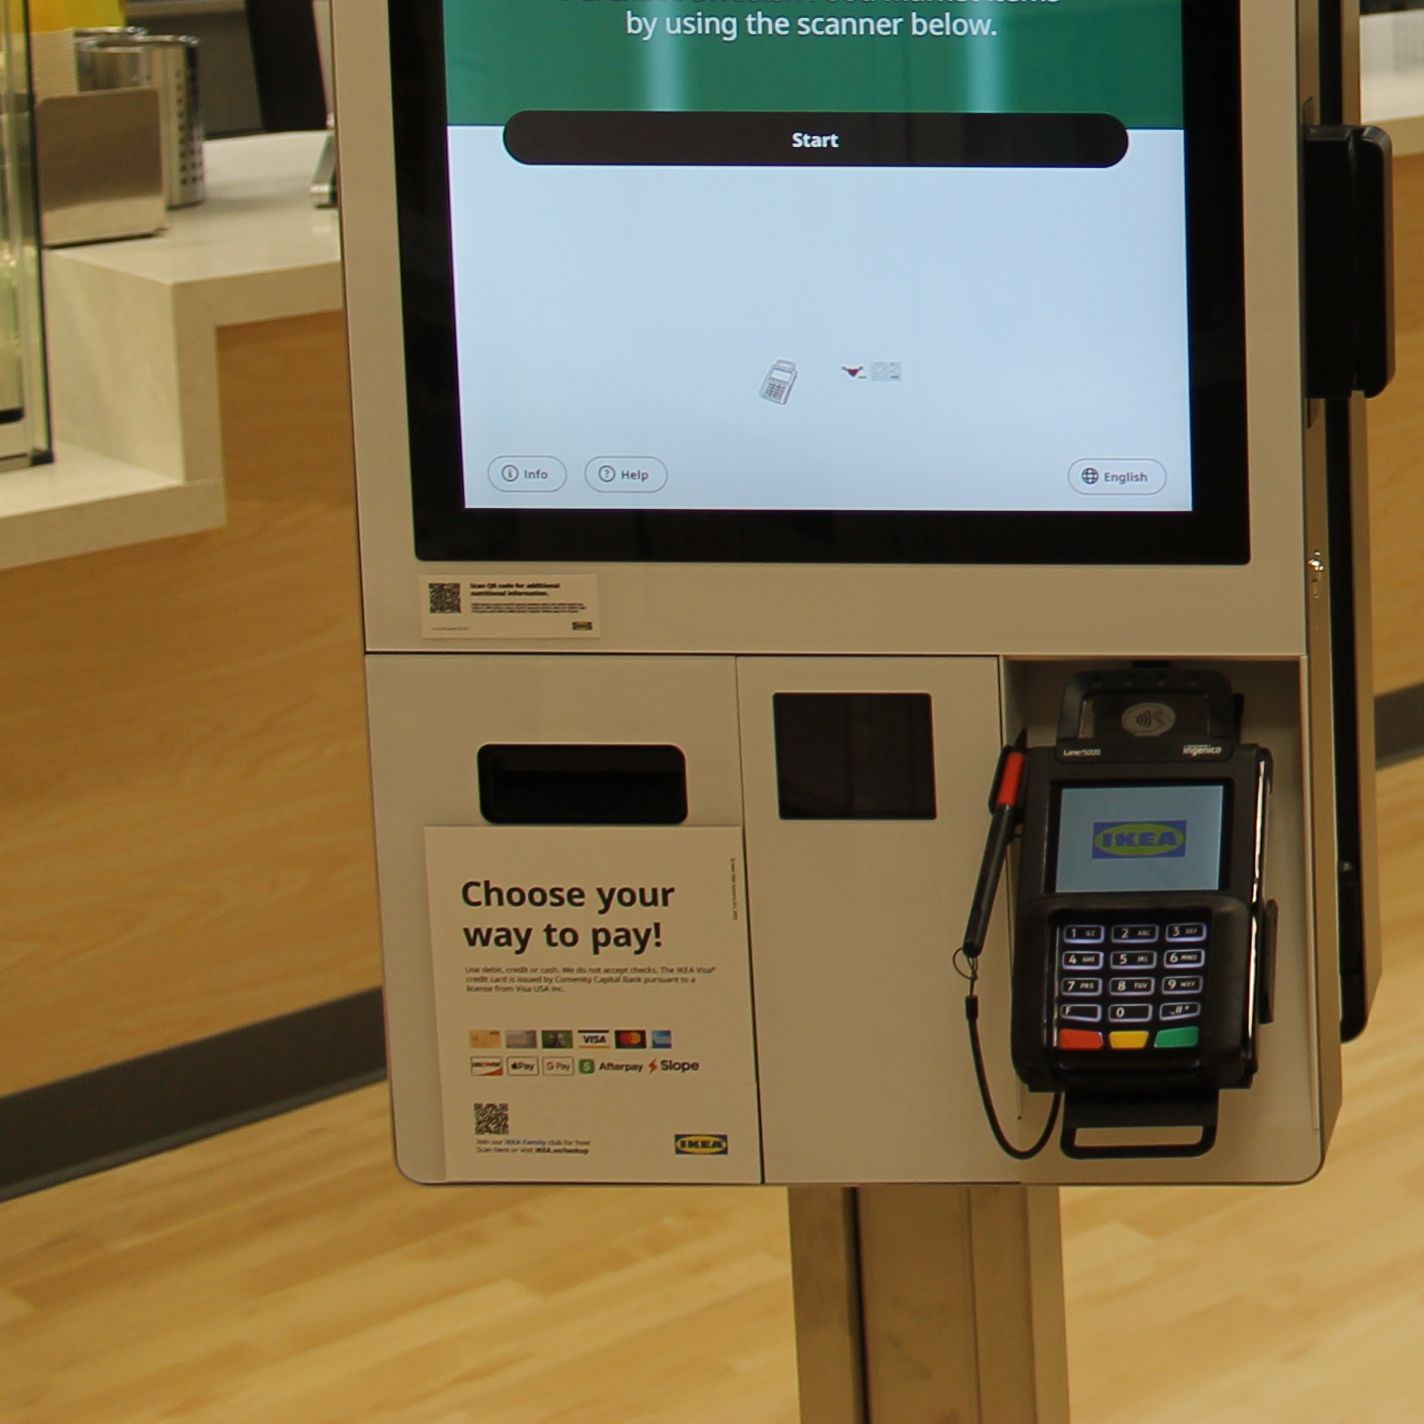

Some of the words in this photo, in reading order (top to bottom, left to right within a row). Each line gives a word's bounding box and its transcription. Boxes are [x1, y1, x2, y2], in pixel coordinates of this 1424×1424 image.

[626, 10, 658, 41] by
[665, 12, 738, 41] using
[746, 11, 790, 35] the
[797, 16, 903, 36] scanner
[911, 12, 997, 36] below.
[792, 132, 839, 148] Start
[524, 469, 548, 480] Info
[621, 469, 649, 482] Help
[1104, 471, 1148, 485] English
[1183, 745, 1222, 756] ingenico
[461, 880, 585, 907] Choose
[596, 886, 675, 915] your
[1121, 928, 1129, 938] 2
[1173, 927, 1180, 937] 3
[463, 927, 533, 955] way
[543, 923, 579, 947] to
[591, 922, 662, 955] pay!
[1068, 955, 1076, 964] 4
[1119, 954, 1127, 964] 5
[1170, 953, 1178, 963] 6
[1067, 981, 1075, 991] 7
[1117, 981, 1126, 991] 8
[1168, 980, 1176, 989] 9
[583, 1035, 606, 1044] VISA
[518, 1062, 535, 1072] Pay
[556, 1063, 570, 1072] Pay
[599, 1062, 643, 1073] Afterpay
[660, 1060, 700, 1073] Slope
